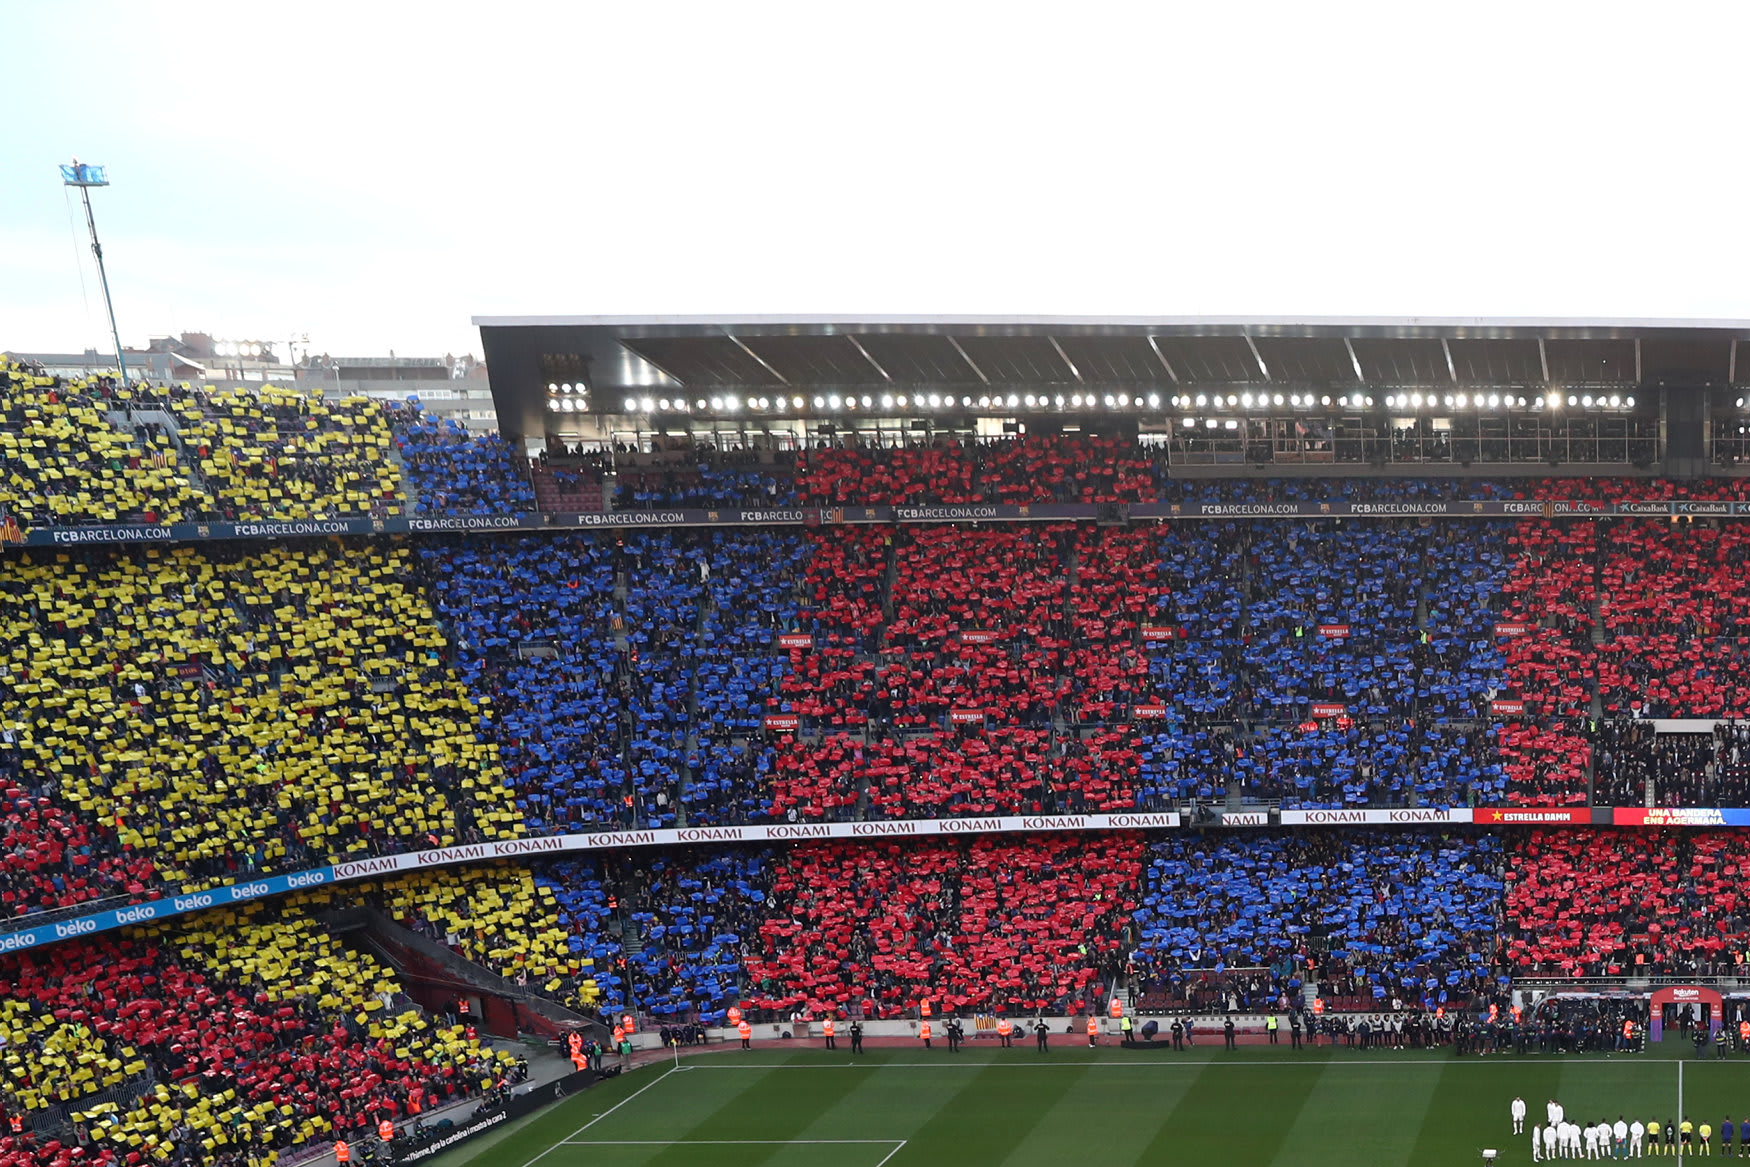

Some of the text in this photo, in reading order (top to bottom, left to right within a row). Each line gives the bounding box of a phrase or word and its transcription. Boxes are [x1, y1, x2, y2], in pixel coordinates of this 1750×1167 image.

[897, 507, 996, 518] FCBARCELONA.COM
[1201, 504, 1298, 514] FCBARCELONA.COM
[1351, 503, 1446, 513] FCBARCELONA.COM
[1631, 504, 1668, 512] CaixaBank
[1689, 504, 1727, 512] CaixaBank
[409, 517, 519, 530] FCBARCELONA.COM
[578, 513, 684, 524] FCBARCELONA.COM
[54, 528, 171, 542] FCBARCELONA.COM
[235, 522, 349, 535] FCBARCELONA.COM
[1305, 811, 1367, 823] KONAMI
[1389, 810, 1450, 821] KONAMI
[1504, 812, 1570, 821] ESTRELLA DAMM
[1648, 809, 1722, 817] UNA BANDERA
[939, 819, 1002, 832] KONAMI
[1023, 816, 1085, 829] KONAMI
[1108, 814, 1170, 827] KONAMI
[1222, 815, 1260, 825] NAMI
[1643, 817, 1662, 825] ENS
[678, 828, 743, 841] KONAMI
[766, 824, 831, 838] KONAMI
[852, 821, 916, 835] KONAMI
[588, 831, 655, 847] KONAMI
[494, 837, 563, 855] KONAMI
[418, 845, 484, 864] KONAMI
[334, 857, 397, 879] KONAMI
[287, 870, 324, 889] beko
[231, 881, 269, 900] beko
[174, 893, 212, 912] beko
[116, 905, 155, 924] beko
[56, 917, 96, 936] beko
[1673, 989, 1699, 997] Rakuten
